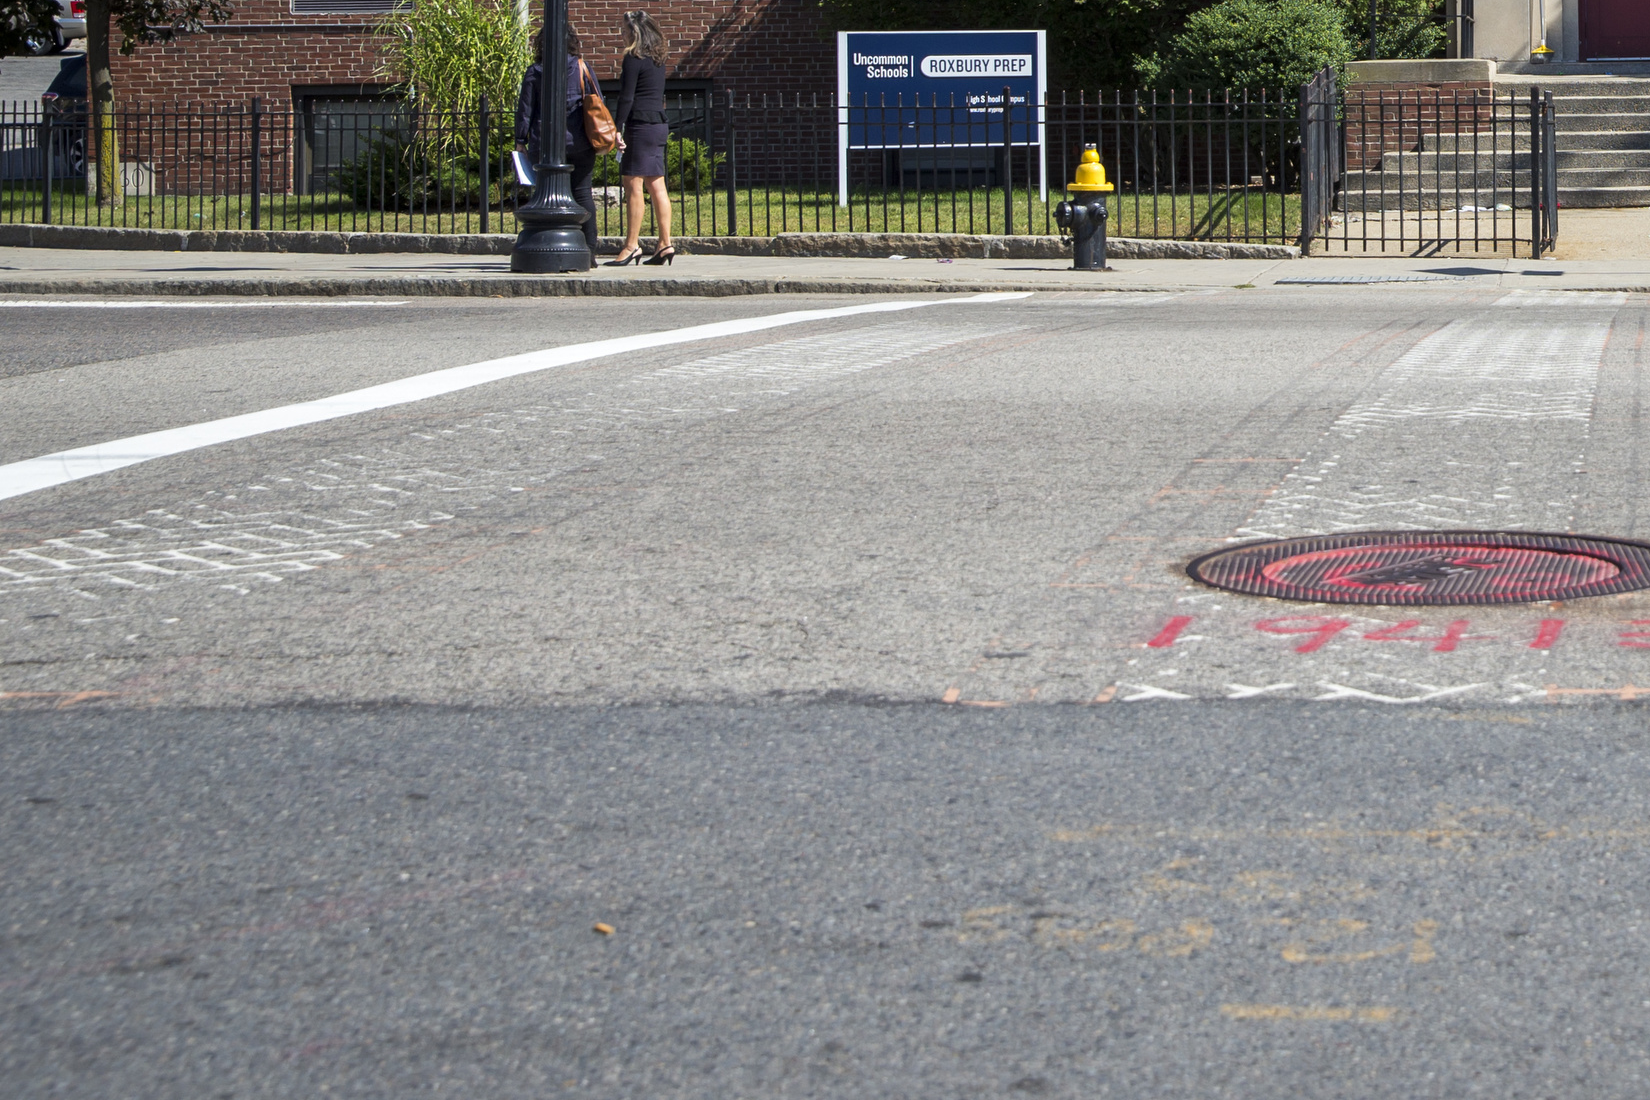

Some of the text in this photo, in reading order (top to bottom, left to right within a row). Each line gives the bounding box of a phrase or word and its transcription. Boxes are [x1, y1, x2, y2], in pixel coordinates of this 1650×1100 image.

[853, 52, 1026, 73] Uncommon ROXBURY PREP
[867, 65, 909, 79] Schools
[980, 95, 1000, 104] Shool
